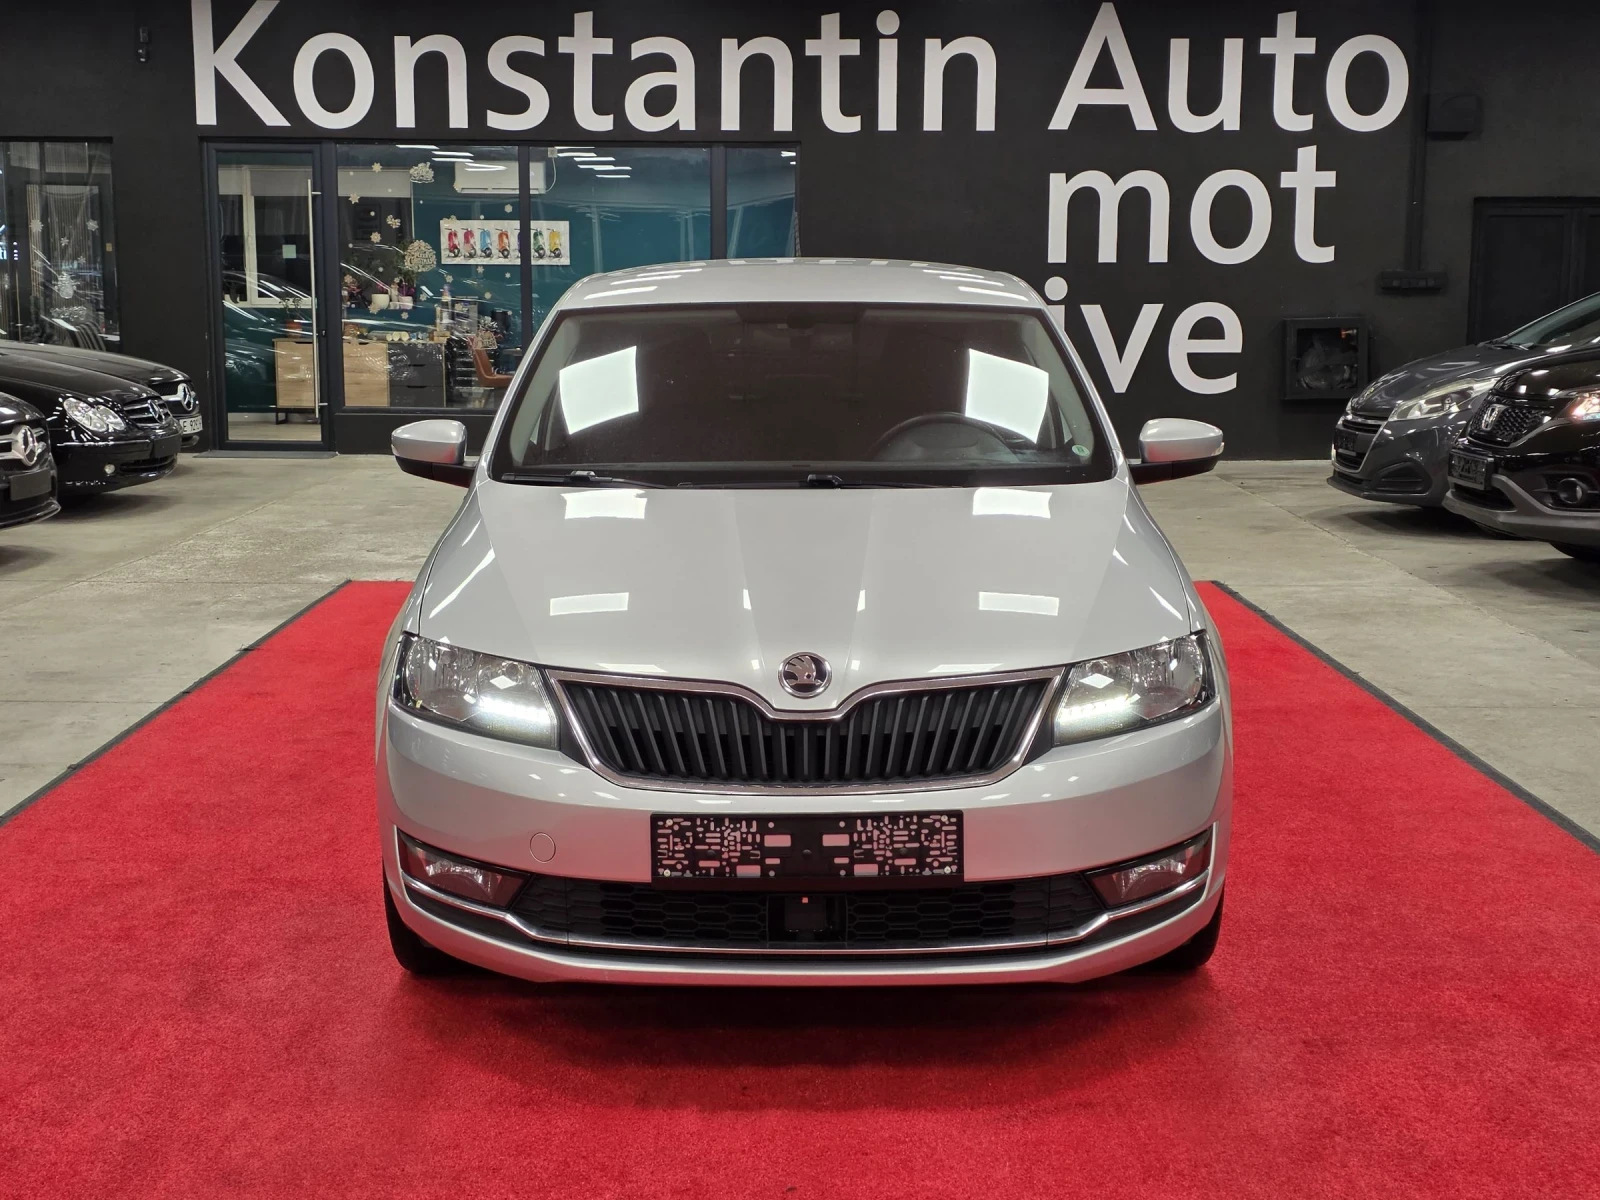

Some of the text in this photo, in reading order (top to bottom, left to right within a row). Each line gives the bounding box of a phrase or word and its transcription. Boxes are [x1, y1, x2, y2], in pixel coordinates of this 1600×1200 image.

[191, 0, 1409, 134] Konstantin Auto
[1047, 144, 1337, 264] mot
